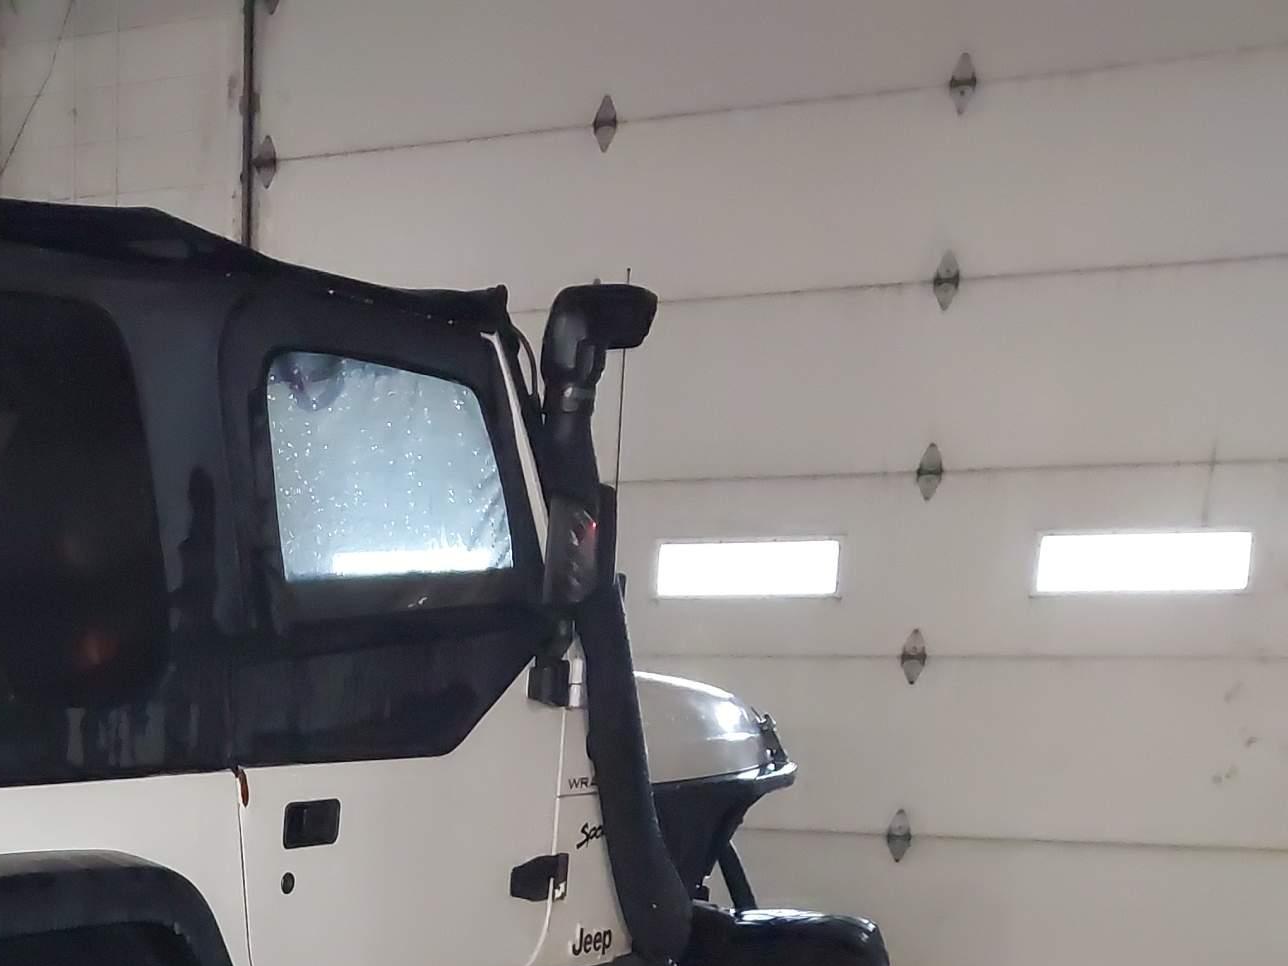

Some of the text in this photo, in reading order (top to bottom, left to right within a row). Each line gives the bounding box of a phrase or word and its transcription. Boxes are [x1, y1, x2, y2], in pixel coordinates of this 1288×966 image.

[567, 776, 597, 790] WR
[576, 822, 605, 849] Spo
[572, 927, 612, 956] Jeep
